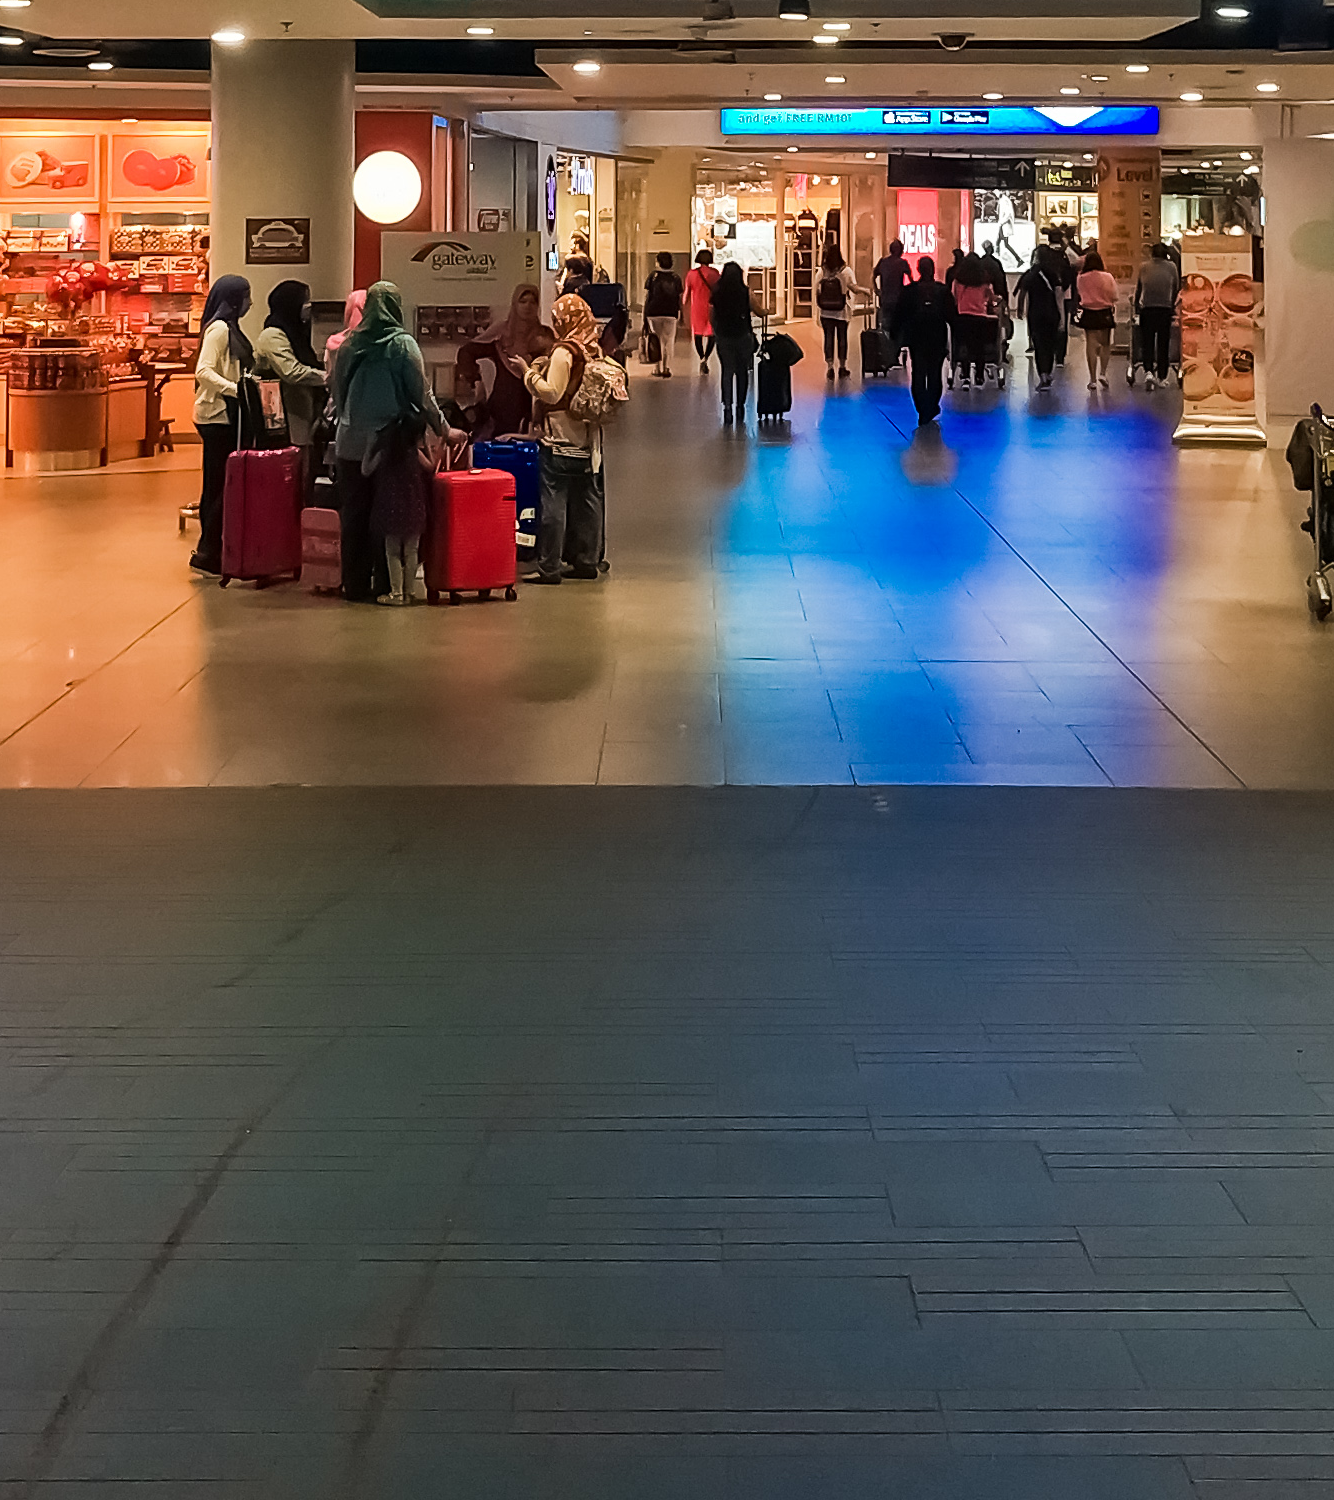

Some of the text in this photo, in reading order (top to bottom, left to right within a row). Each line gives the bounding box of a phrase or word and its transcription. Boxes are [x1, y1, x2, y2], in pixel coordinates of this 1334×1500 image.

[738, 113, 759, 123] and
[786, 113, 813, 122] FREE
[900, 225, 936, 253] DEALS
[432, 251, 497, 271] gateway
